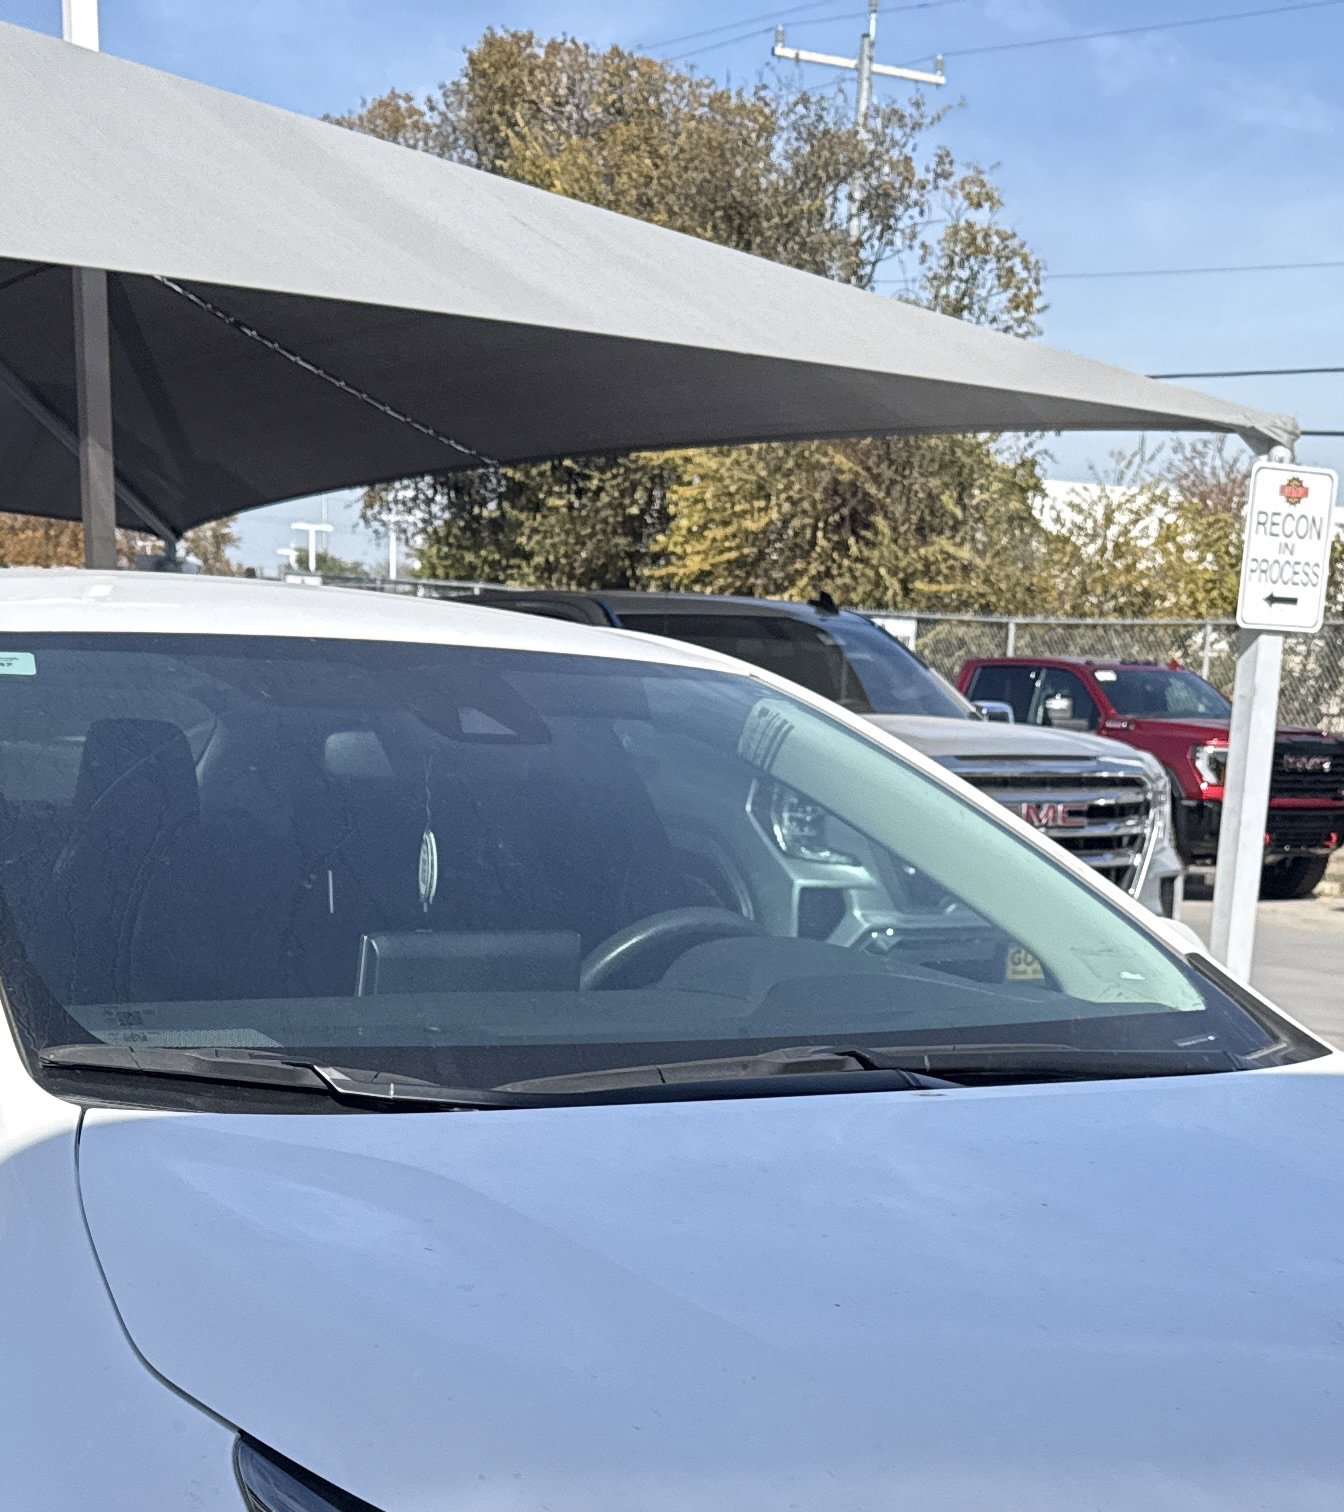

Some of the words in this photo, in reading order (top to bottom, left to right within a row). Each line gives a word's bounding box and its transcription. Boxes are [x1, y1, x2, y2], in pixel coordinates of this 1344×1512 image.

[1256, 511, 1323, 540] RECON
[1278, 542, 1296, 556] IN
[1248, 558, 1321, 587] PROCESS
